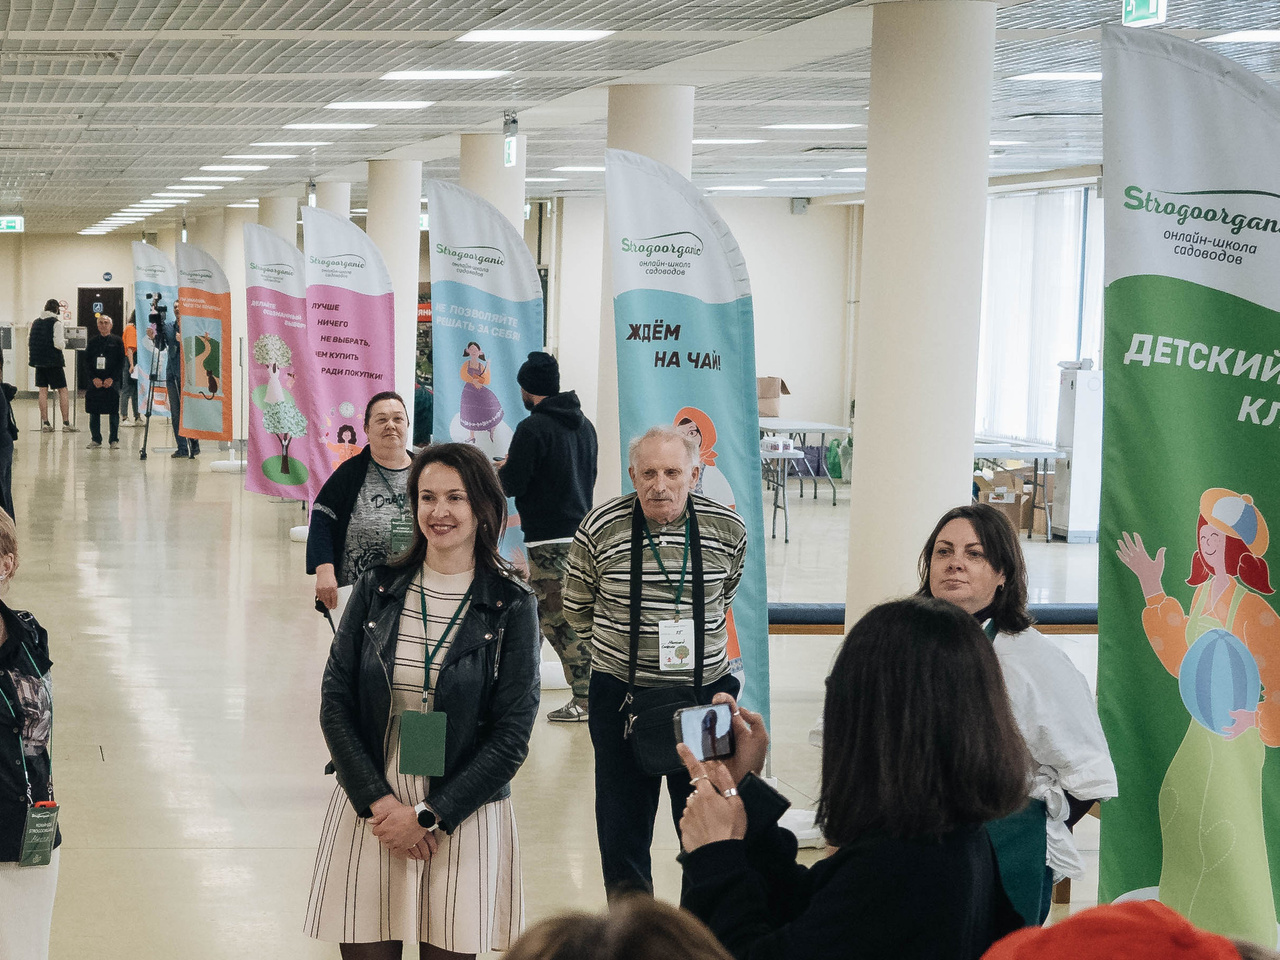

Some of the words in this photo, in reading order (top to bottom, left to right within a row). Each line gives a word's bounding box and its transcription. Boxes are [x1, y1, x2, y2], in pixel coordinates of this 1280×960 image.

[1123, 185, 1280, 235] Strogoorgan
[621, 237, 701, 258] Strogoorganic
[1163, 230, 1258, 255] онлайн-школа
[310, 256, 365, 269] Strogoorganic
[436, 243, 504, 266] Strogoorganic
[639, 260, 691, 268] онлайн-школа
[1174, 245, 1243, 265] садоводов
[645, 268, 686, 276] садоводов
[312, 302, 340, 311] ЛУЧШЕ
[450, 304, 518, 328] ПОЗВОЛЯЙТЕ
[317, 319, 348, 328] НИЧЕГО
[436, 315, 475, 331] РЕШАТЬ
[477, 323, 489, 335] ЗА
[491, 327, 521, 341] СЕБЯ!
[626, 319, 681, 343] ЖДЁМ
[320, 335, 331, 343] НЕ
[332, 336, 370, 347] ВЫБРАТЬ,
[328, 352, 359, 361] КУПИТЬ
[654, 351, 681, 368] НА
[687, 349, 721, 371] ЧАЙ!
[1123, 333, 1280, 385] ДЕТСКИЙ
[321, 367, 344, 376] РАДИ
[344, 369, 383, 381] ПОКУПКИ!
[1237, 396, 1280, 426] КЛ
